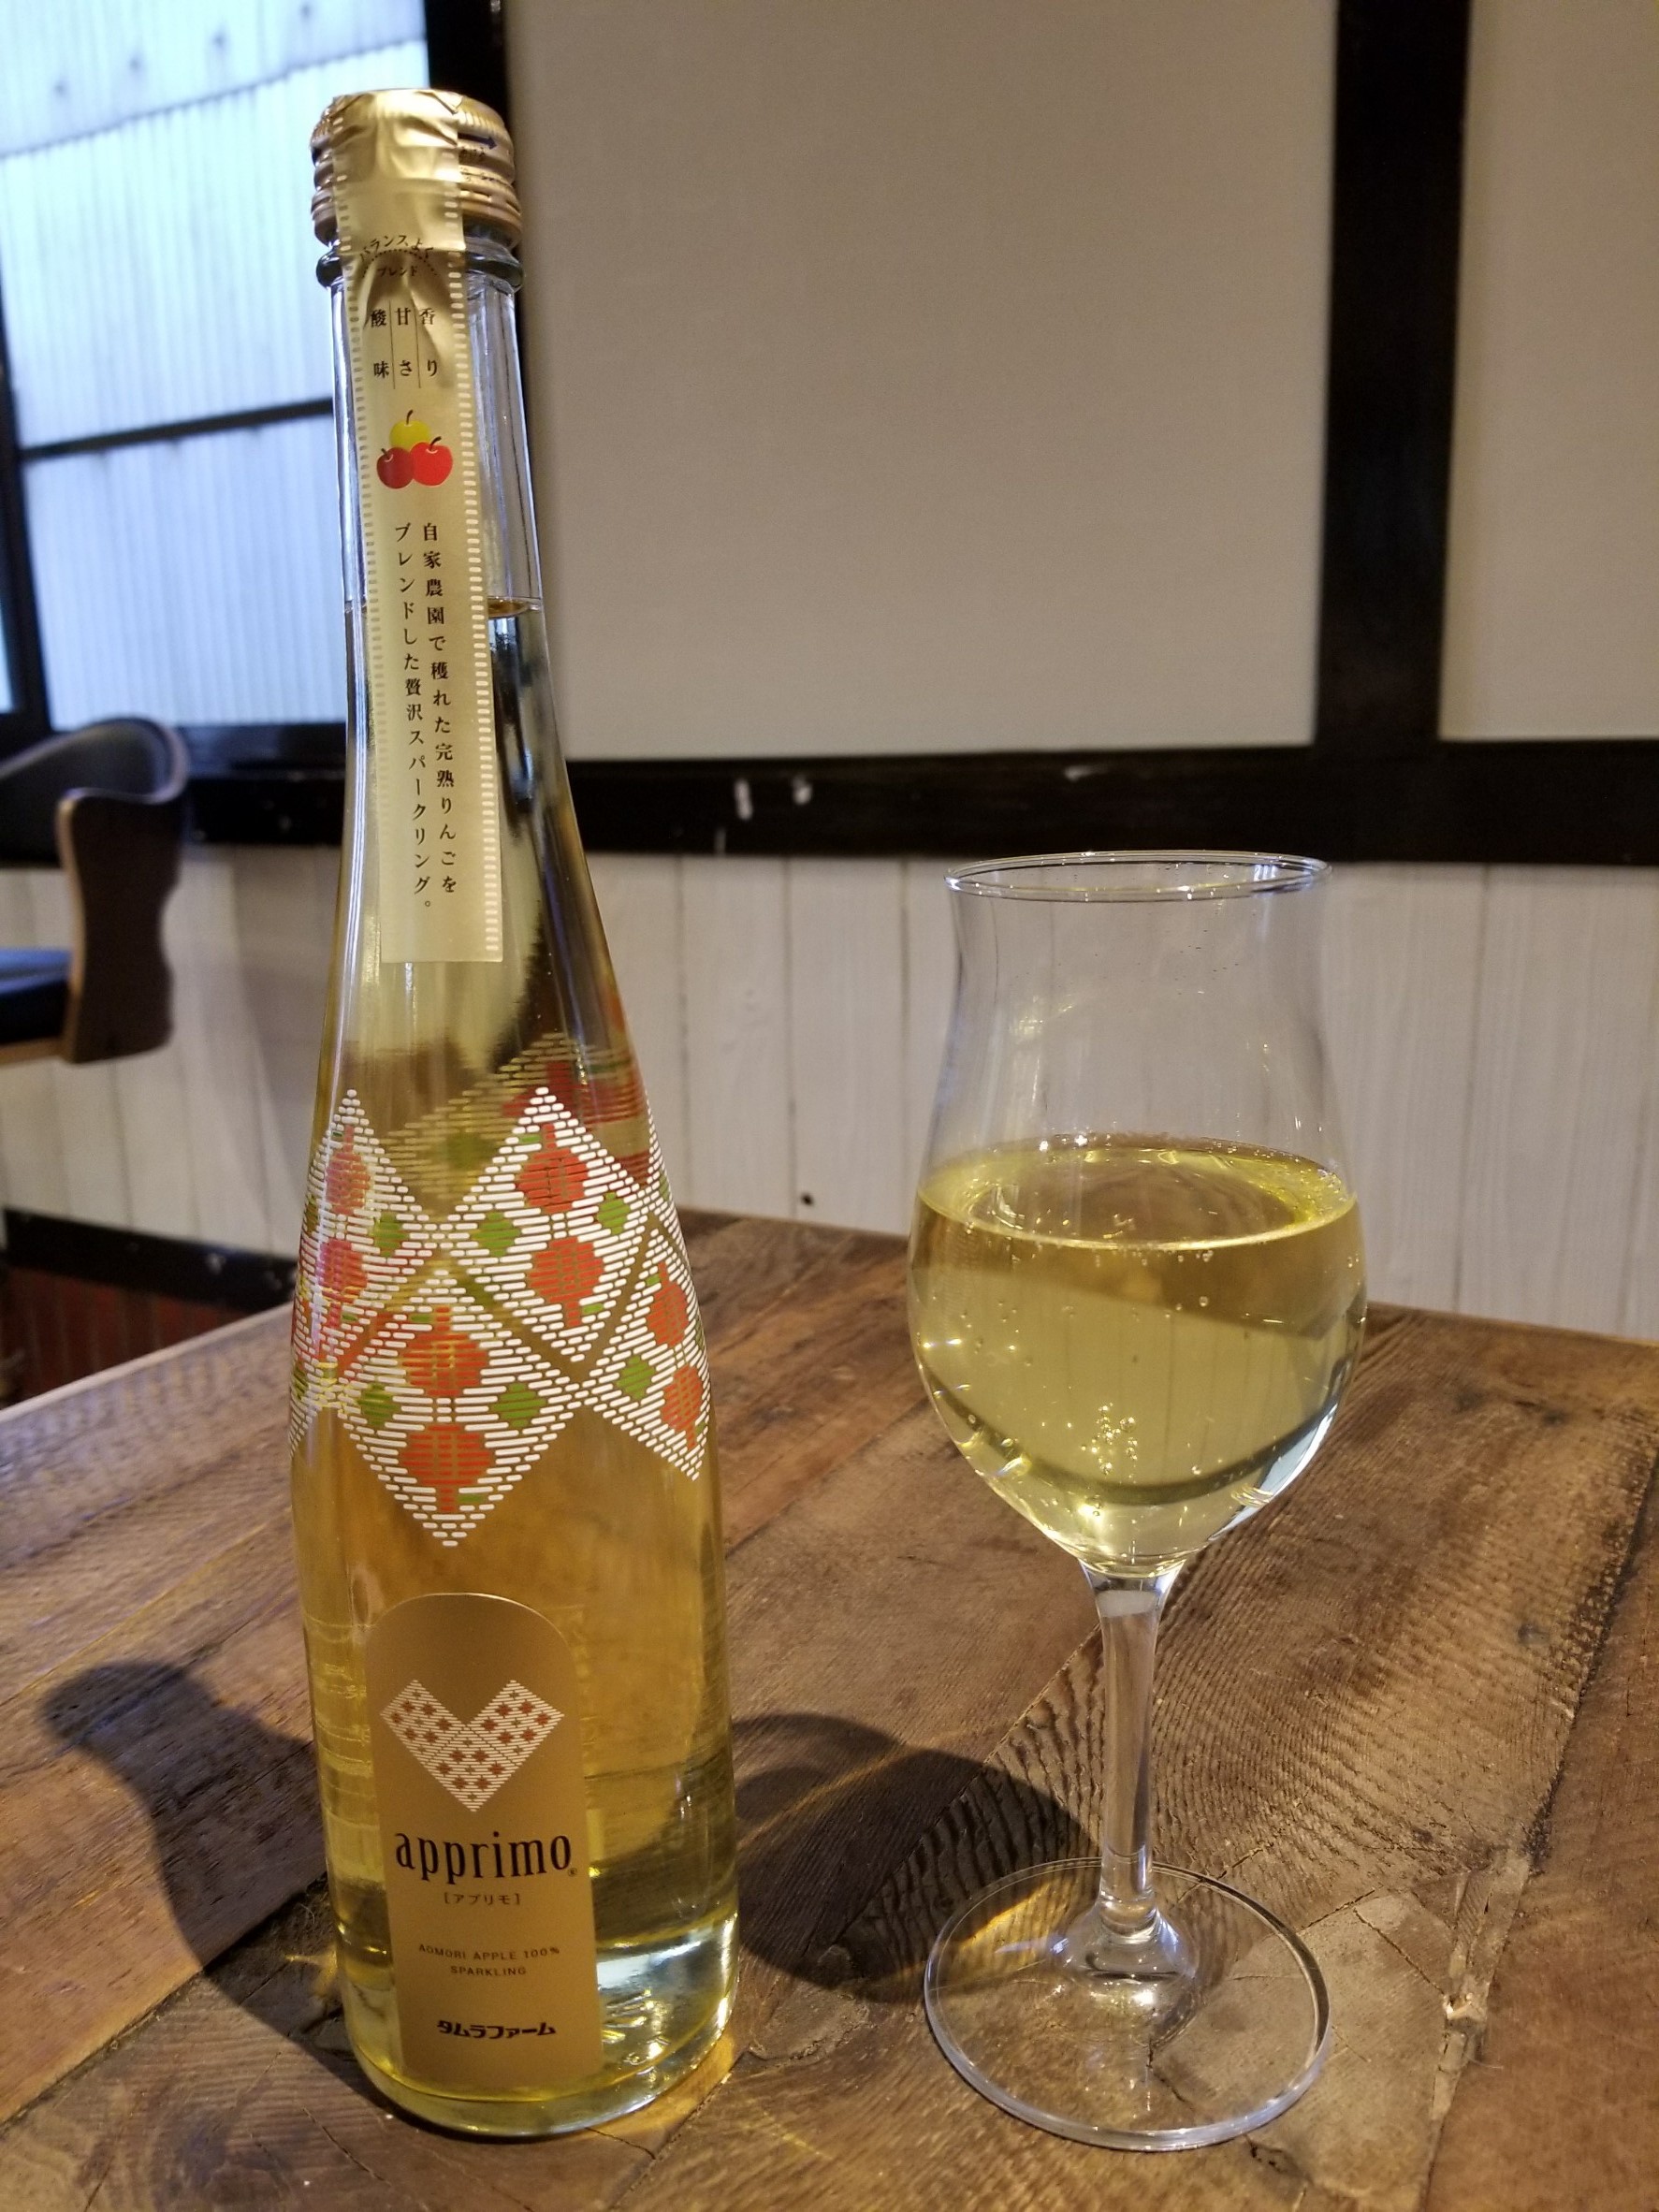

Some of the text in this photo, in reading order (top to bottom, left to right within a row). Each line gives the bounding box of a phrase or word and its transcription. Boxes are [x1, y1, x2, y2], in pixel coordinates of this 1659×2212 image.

[370, 307, 390, 377] 酸味
[394, 306, 413, 376] 甘さ
[419, 307, 439, 377] 香り
[395, 1830, 572, 1885] apprimo
[418, 1943, 560, 1961] AOMORI APPLE 100%
[450, 1965, 528, 1977] SPARKLING
[436, 2019, 557, 2040] タムラファーム
